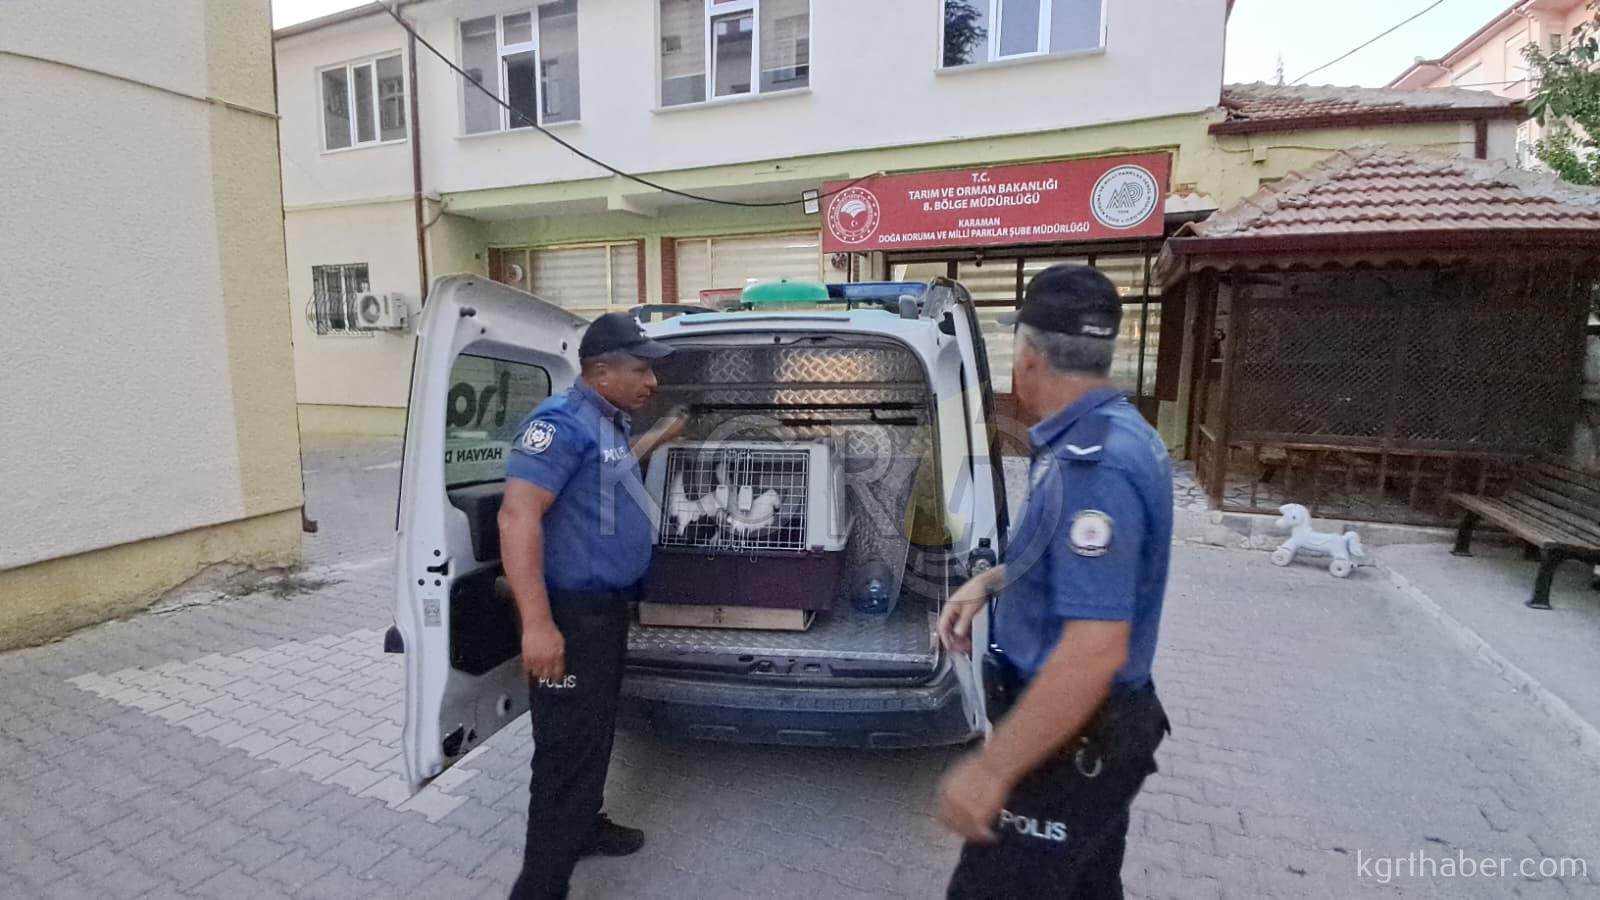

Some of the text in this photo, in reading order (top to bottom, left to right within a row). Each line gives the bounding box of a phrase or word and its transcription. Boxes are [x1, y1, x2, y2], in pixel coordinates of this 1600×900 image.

[972, 172, 990, 183] T.C.
[908, 178, 1058, 200] TARIM VE ORMAN BAKANLIĞI
[923, 193, 1040, 211] 8. BÖLGE MÜDÜRLÜĞÜ
[958, 217, 1001, 228] KARAMAN
[879, 221, 1090, 243] DOĞA KORUMA VE MİLLİ PARKLAR ŞUBE MÜDÜRLÜĞÜ
